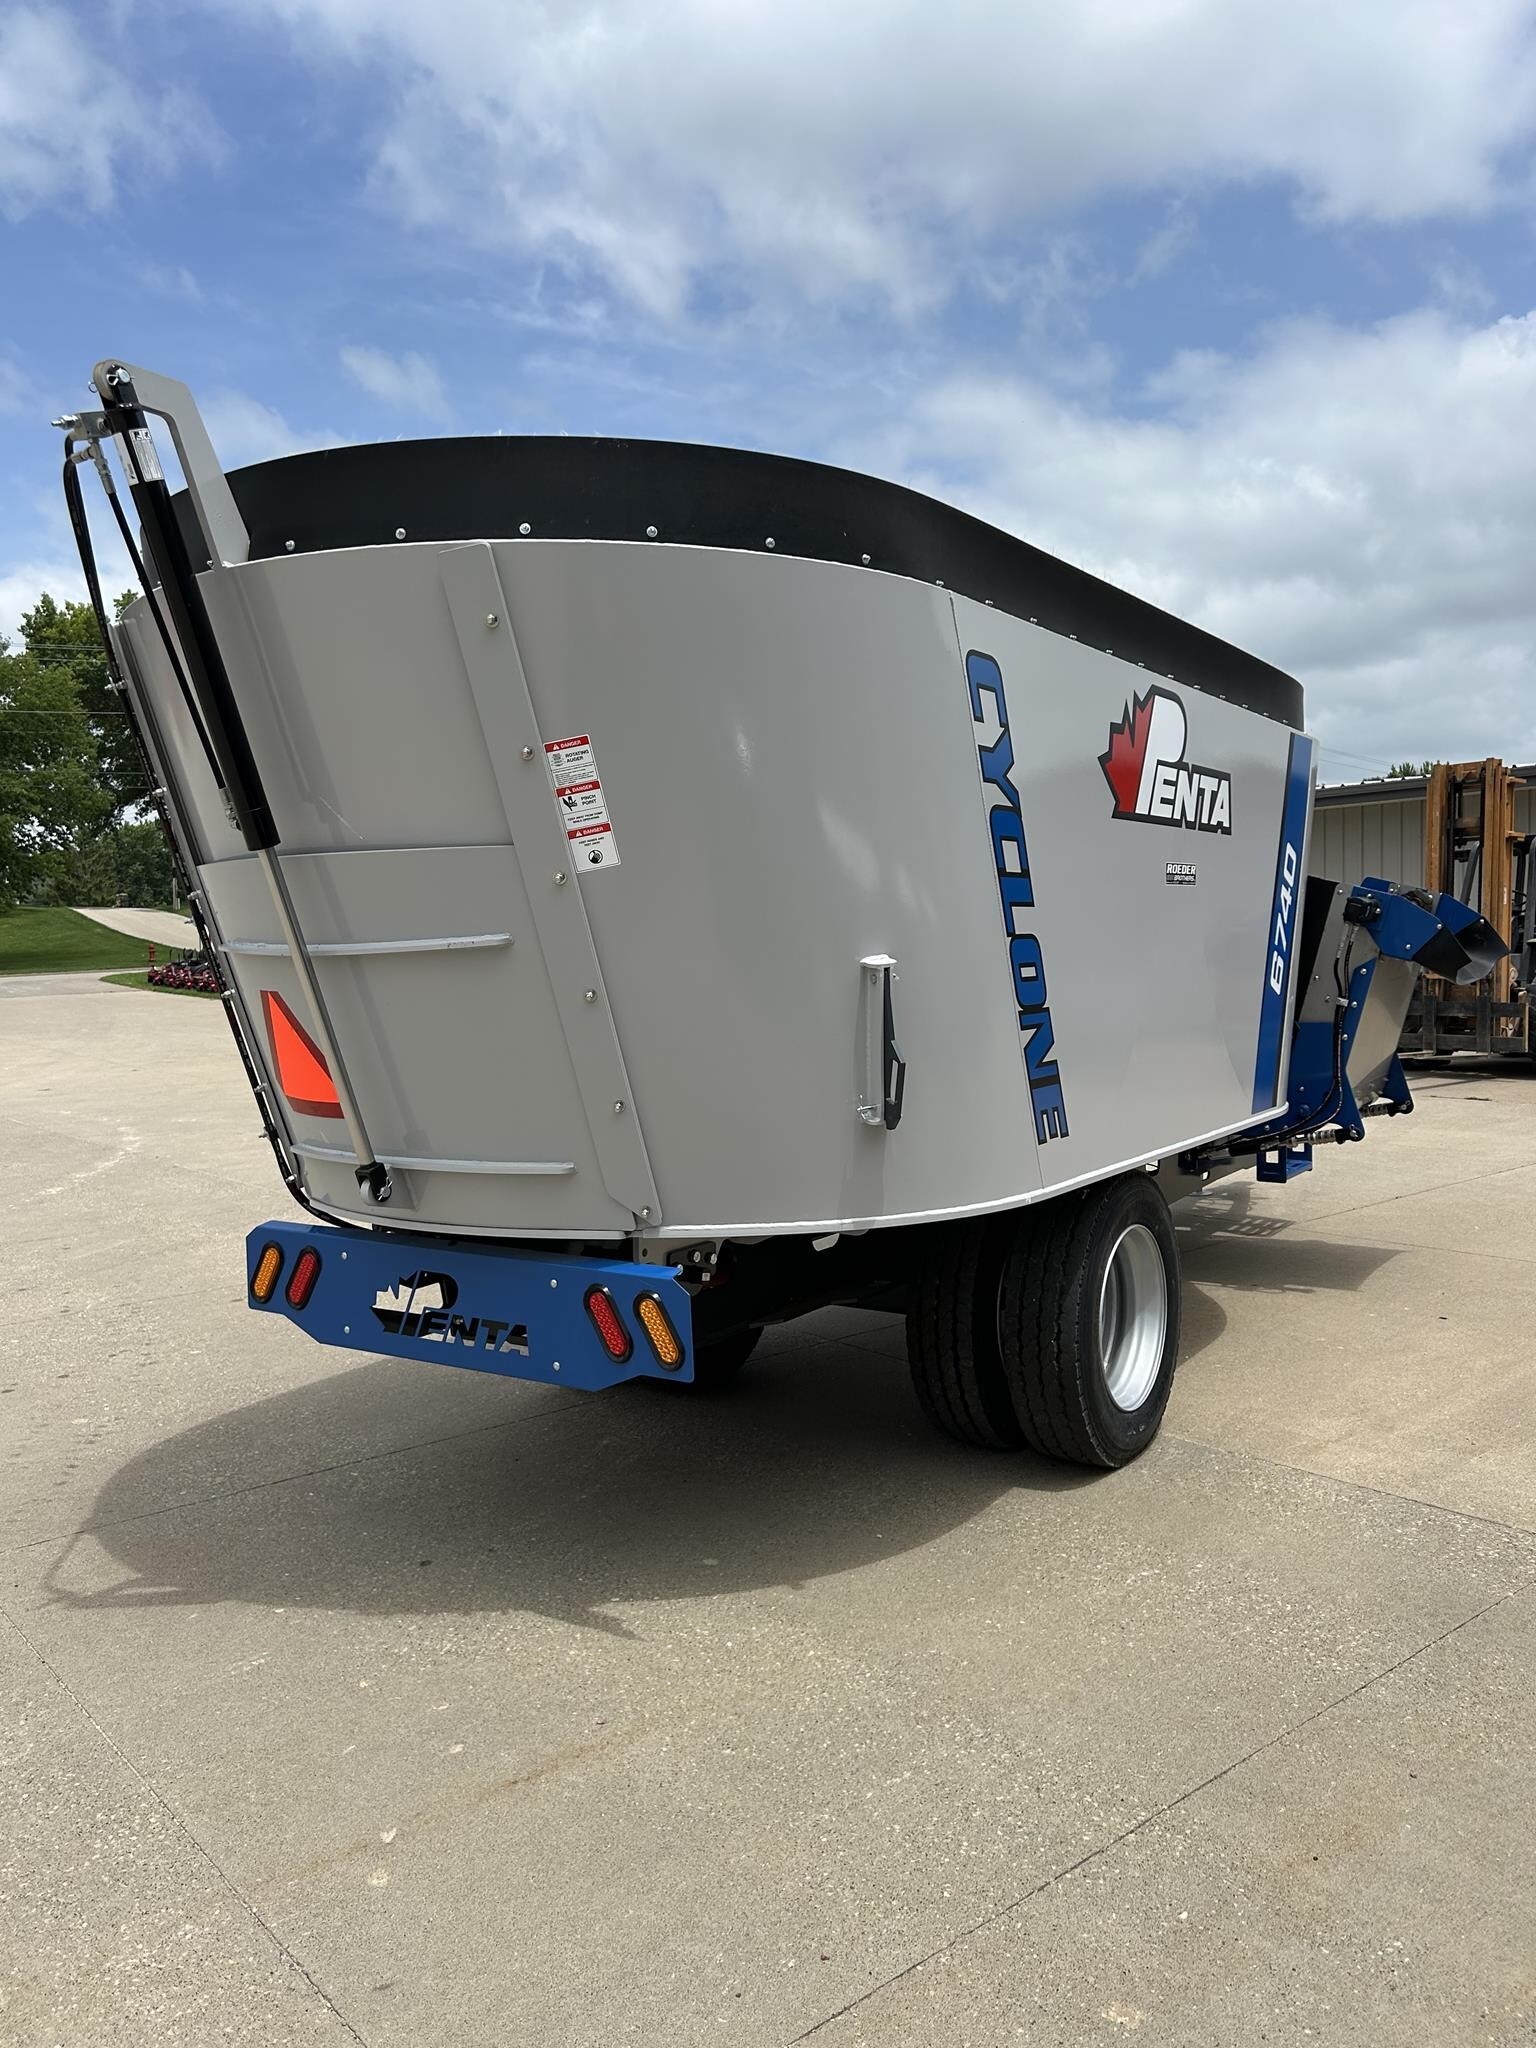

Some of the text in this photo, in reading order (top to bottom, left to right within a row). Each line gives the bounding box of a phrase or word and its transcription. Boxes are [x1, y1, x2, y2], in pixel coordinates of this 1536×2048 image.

[560, 740, 582, 749] DANGER
[1134, 693, 1231, 829] PENTA
[571, 784, 593, 793] DANGER
[965, 649, 1070, 1146] CYCLONE
[1166, 863, 1196, 875] ROEDER
[1270, 842, 1297, 996] 6740
[400, 1270, 530, 1357] PENTA
